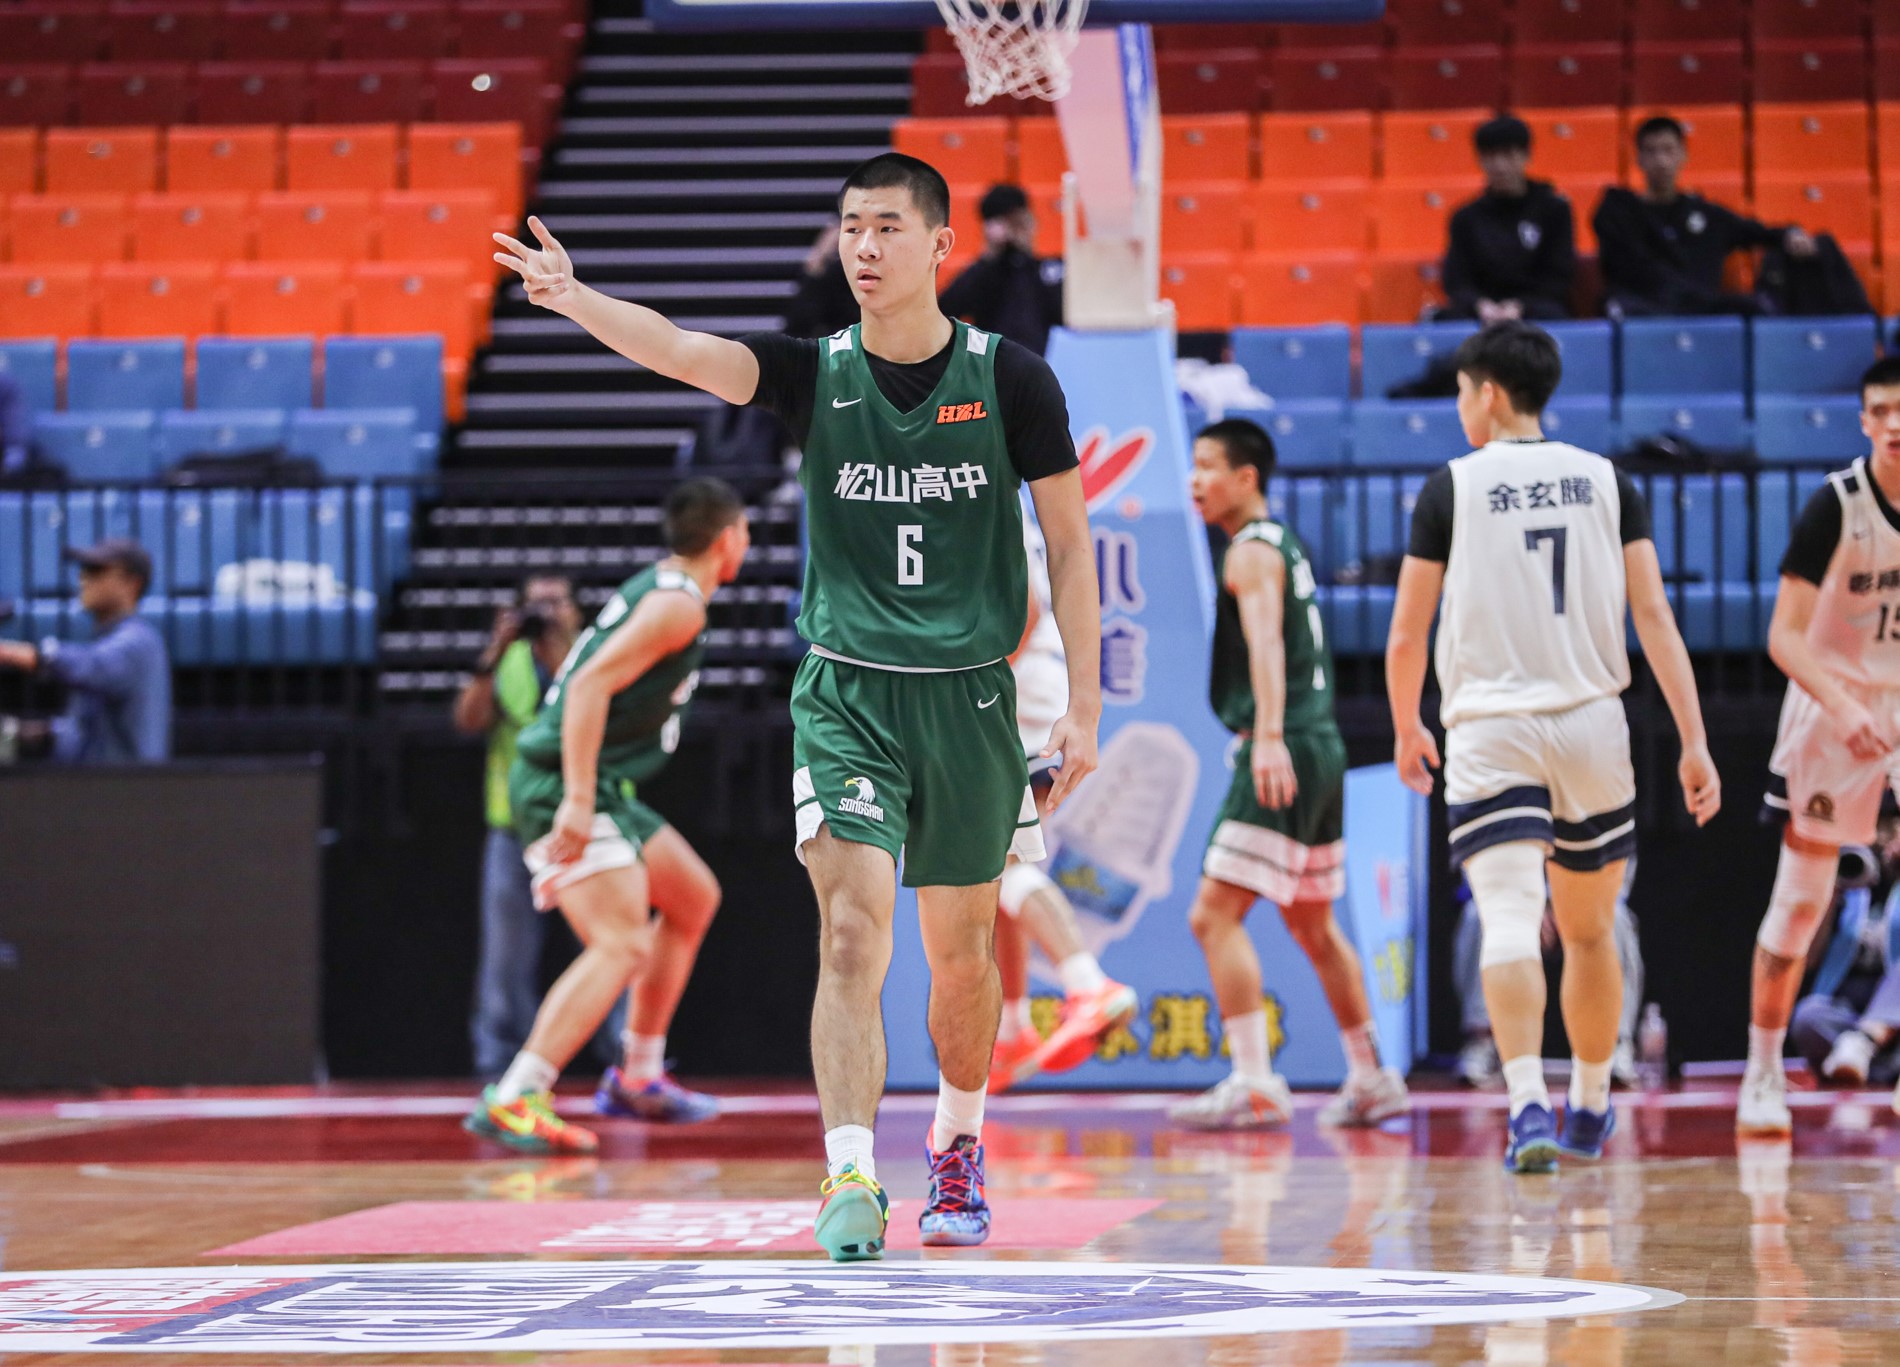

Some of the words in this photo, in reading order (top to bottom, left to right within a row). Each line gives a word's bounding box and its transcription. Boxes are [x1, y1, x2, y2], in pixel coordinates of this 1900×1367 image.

[936, 401, 987, 424] HBL
[834, 462, 988, 503] 松山高中
[1488, 475, 1593, 512] 余玄騰
[897, 524, 924, 585] 6
[1524, 526, 1567, 614] 7
[838, 797, 884, 823] SONGSHAN
